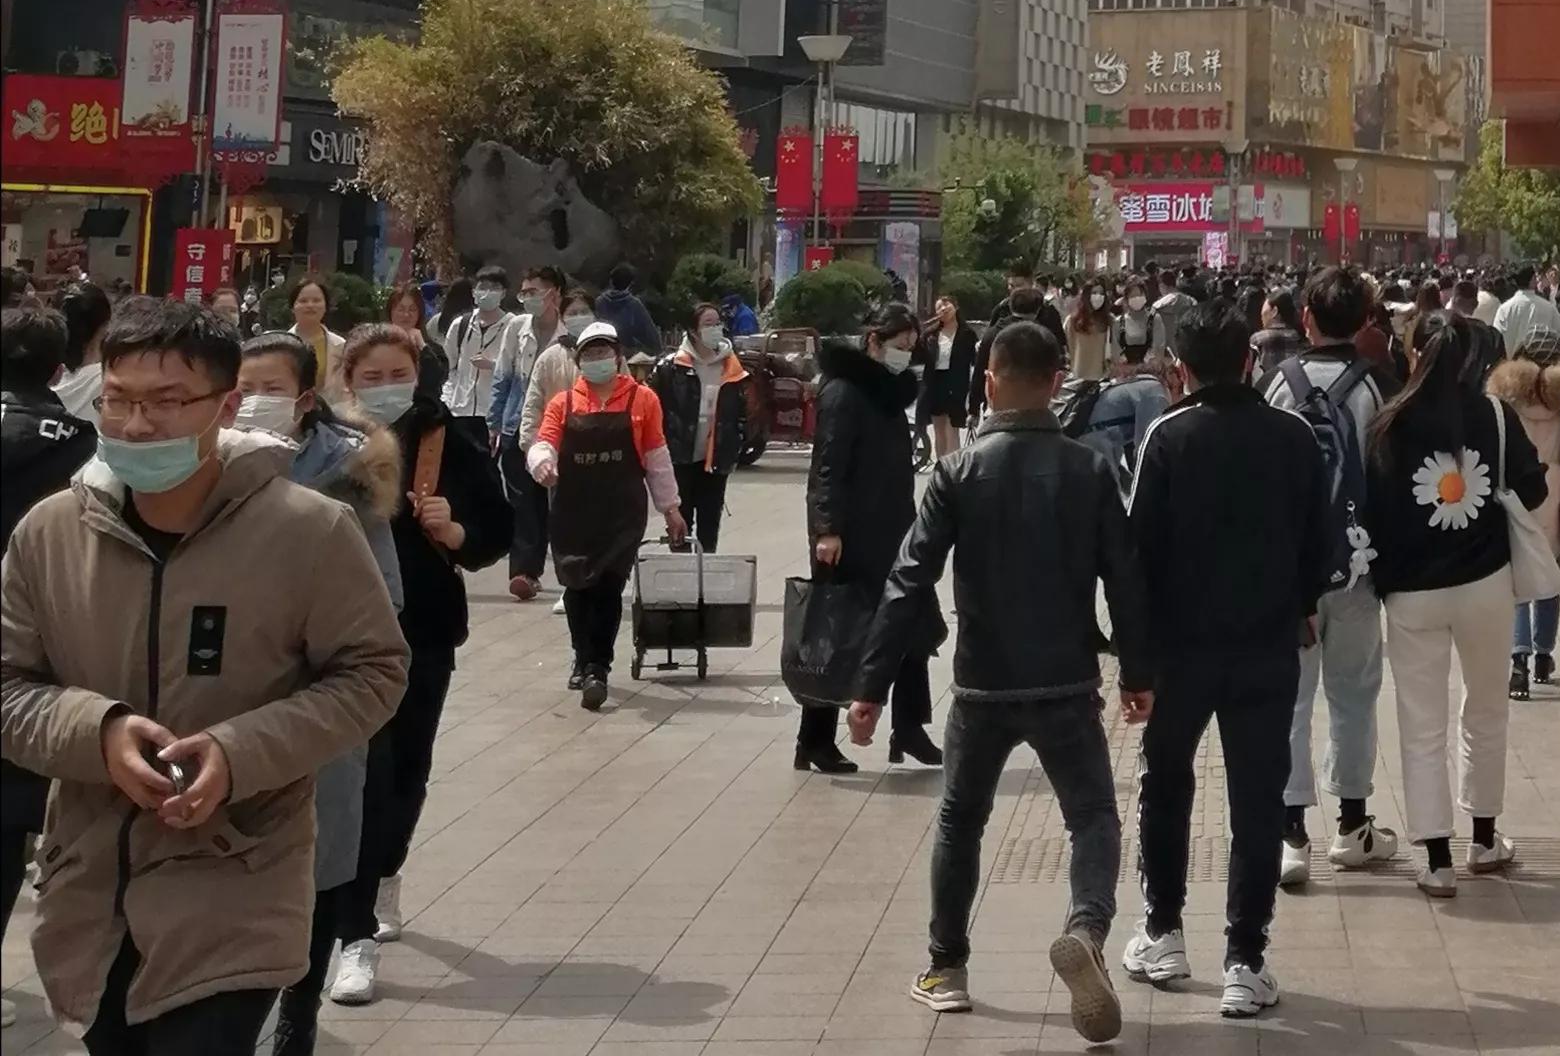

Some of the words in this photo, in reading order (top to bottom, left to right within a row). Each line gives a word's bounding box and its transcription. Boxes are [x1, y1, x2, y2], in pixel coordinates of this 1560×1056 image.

[1145, 48, 1223, 79] 老鳳祥
[70, 100, 120, 144] 绝
